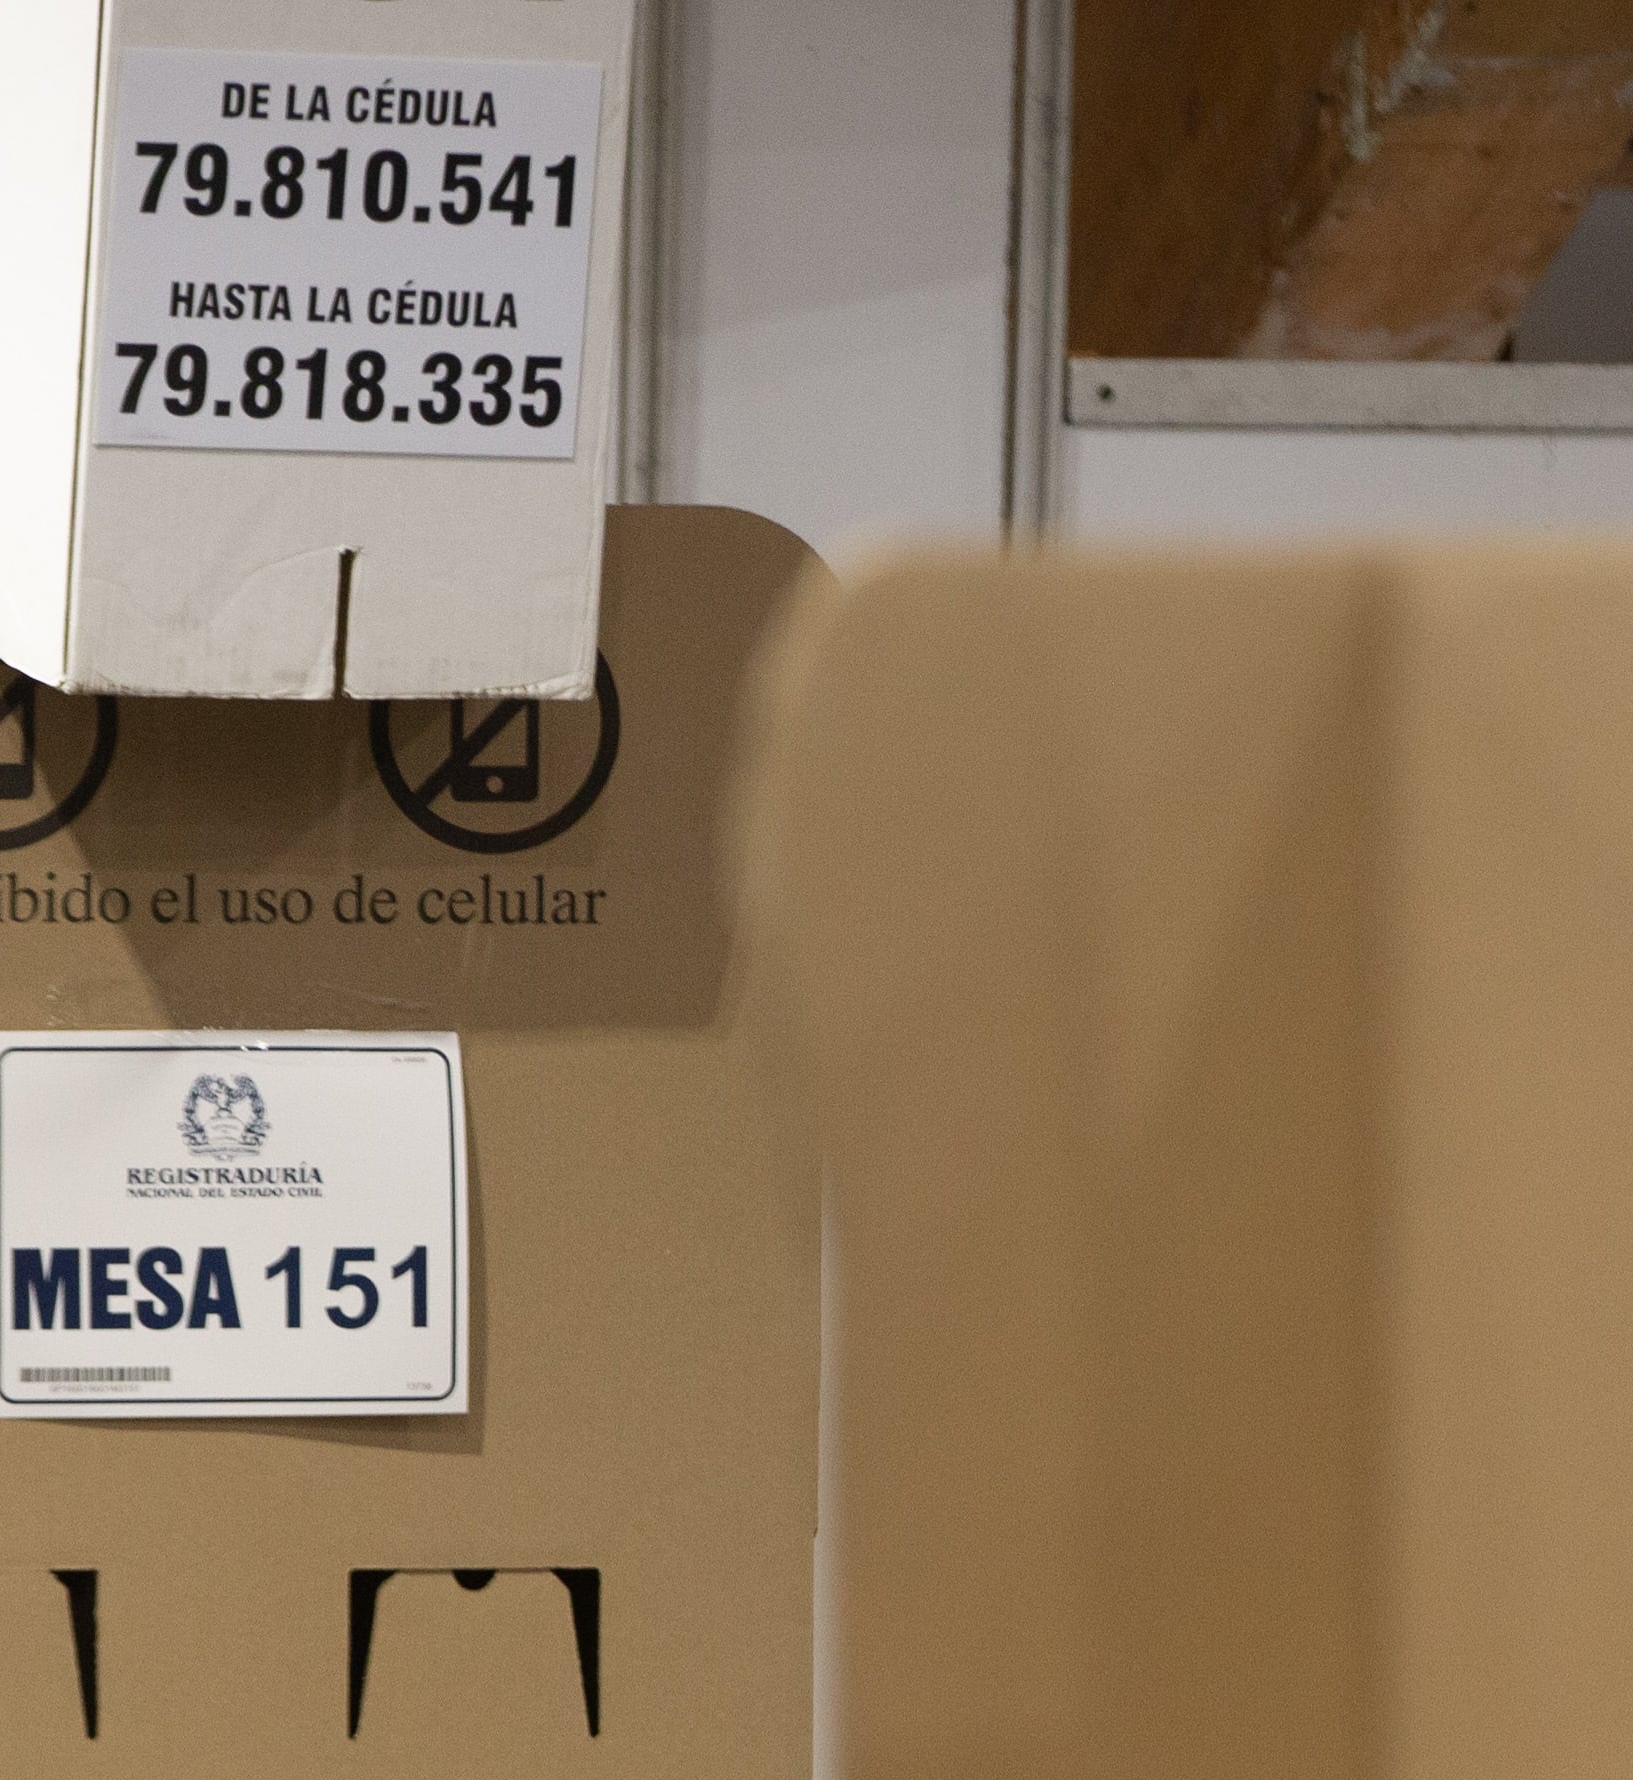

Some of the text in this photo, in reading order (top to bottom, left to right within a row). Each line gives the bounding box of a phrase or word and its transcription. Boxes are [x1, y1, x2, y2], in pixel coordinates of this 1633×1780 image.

[222, 79, 497, 127] DE LA CÉDULA
[134, 142, 577, 228] 79.810.541
[168, 281, 518, 329] HASTA LA CÉDULA
[115, 342, 564, 428] 79.818.335
[150, 873, 198, 924] el
[220, 884, 313, 925] uso
[332, 874, 397, 924] de
[416, 874, 607, 925] celular
[126, 1161, 323, 1185] REGISTRADURÍA
[126, 1187, 323, 1198] NACIONAL DEL ESTADO CIVIL
[11, 1245, 428, 1330] MESA 151
